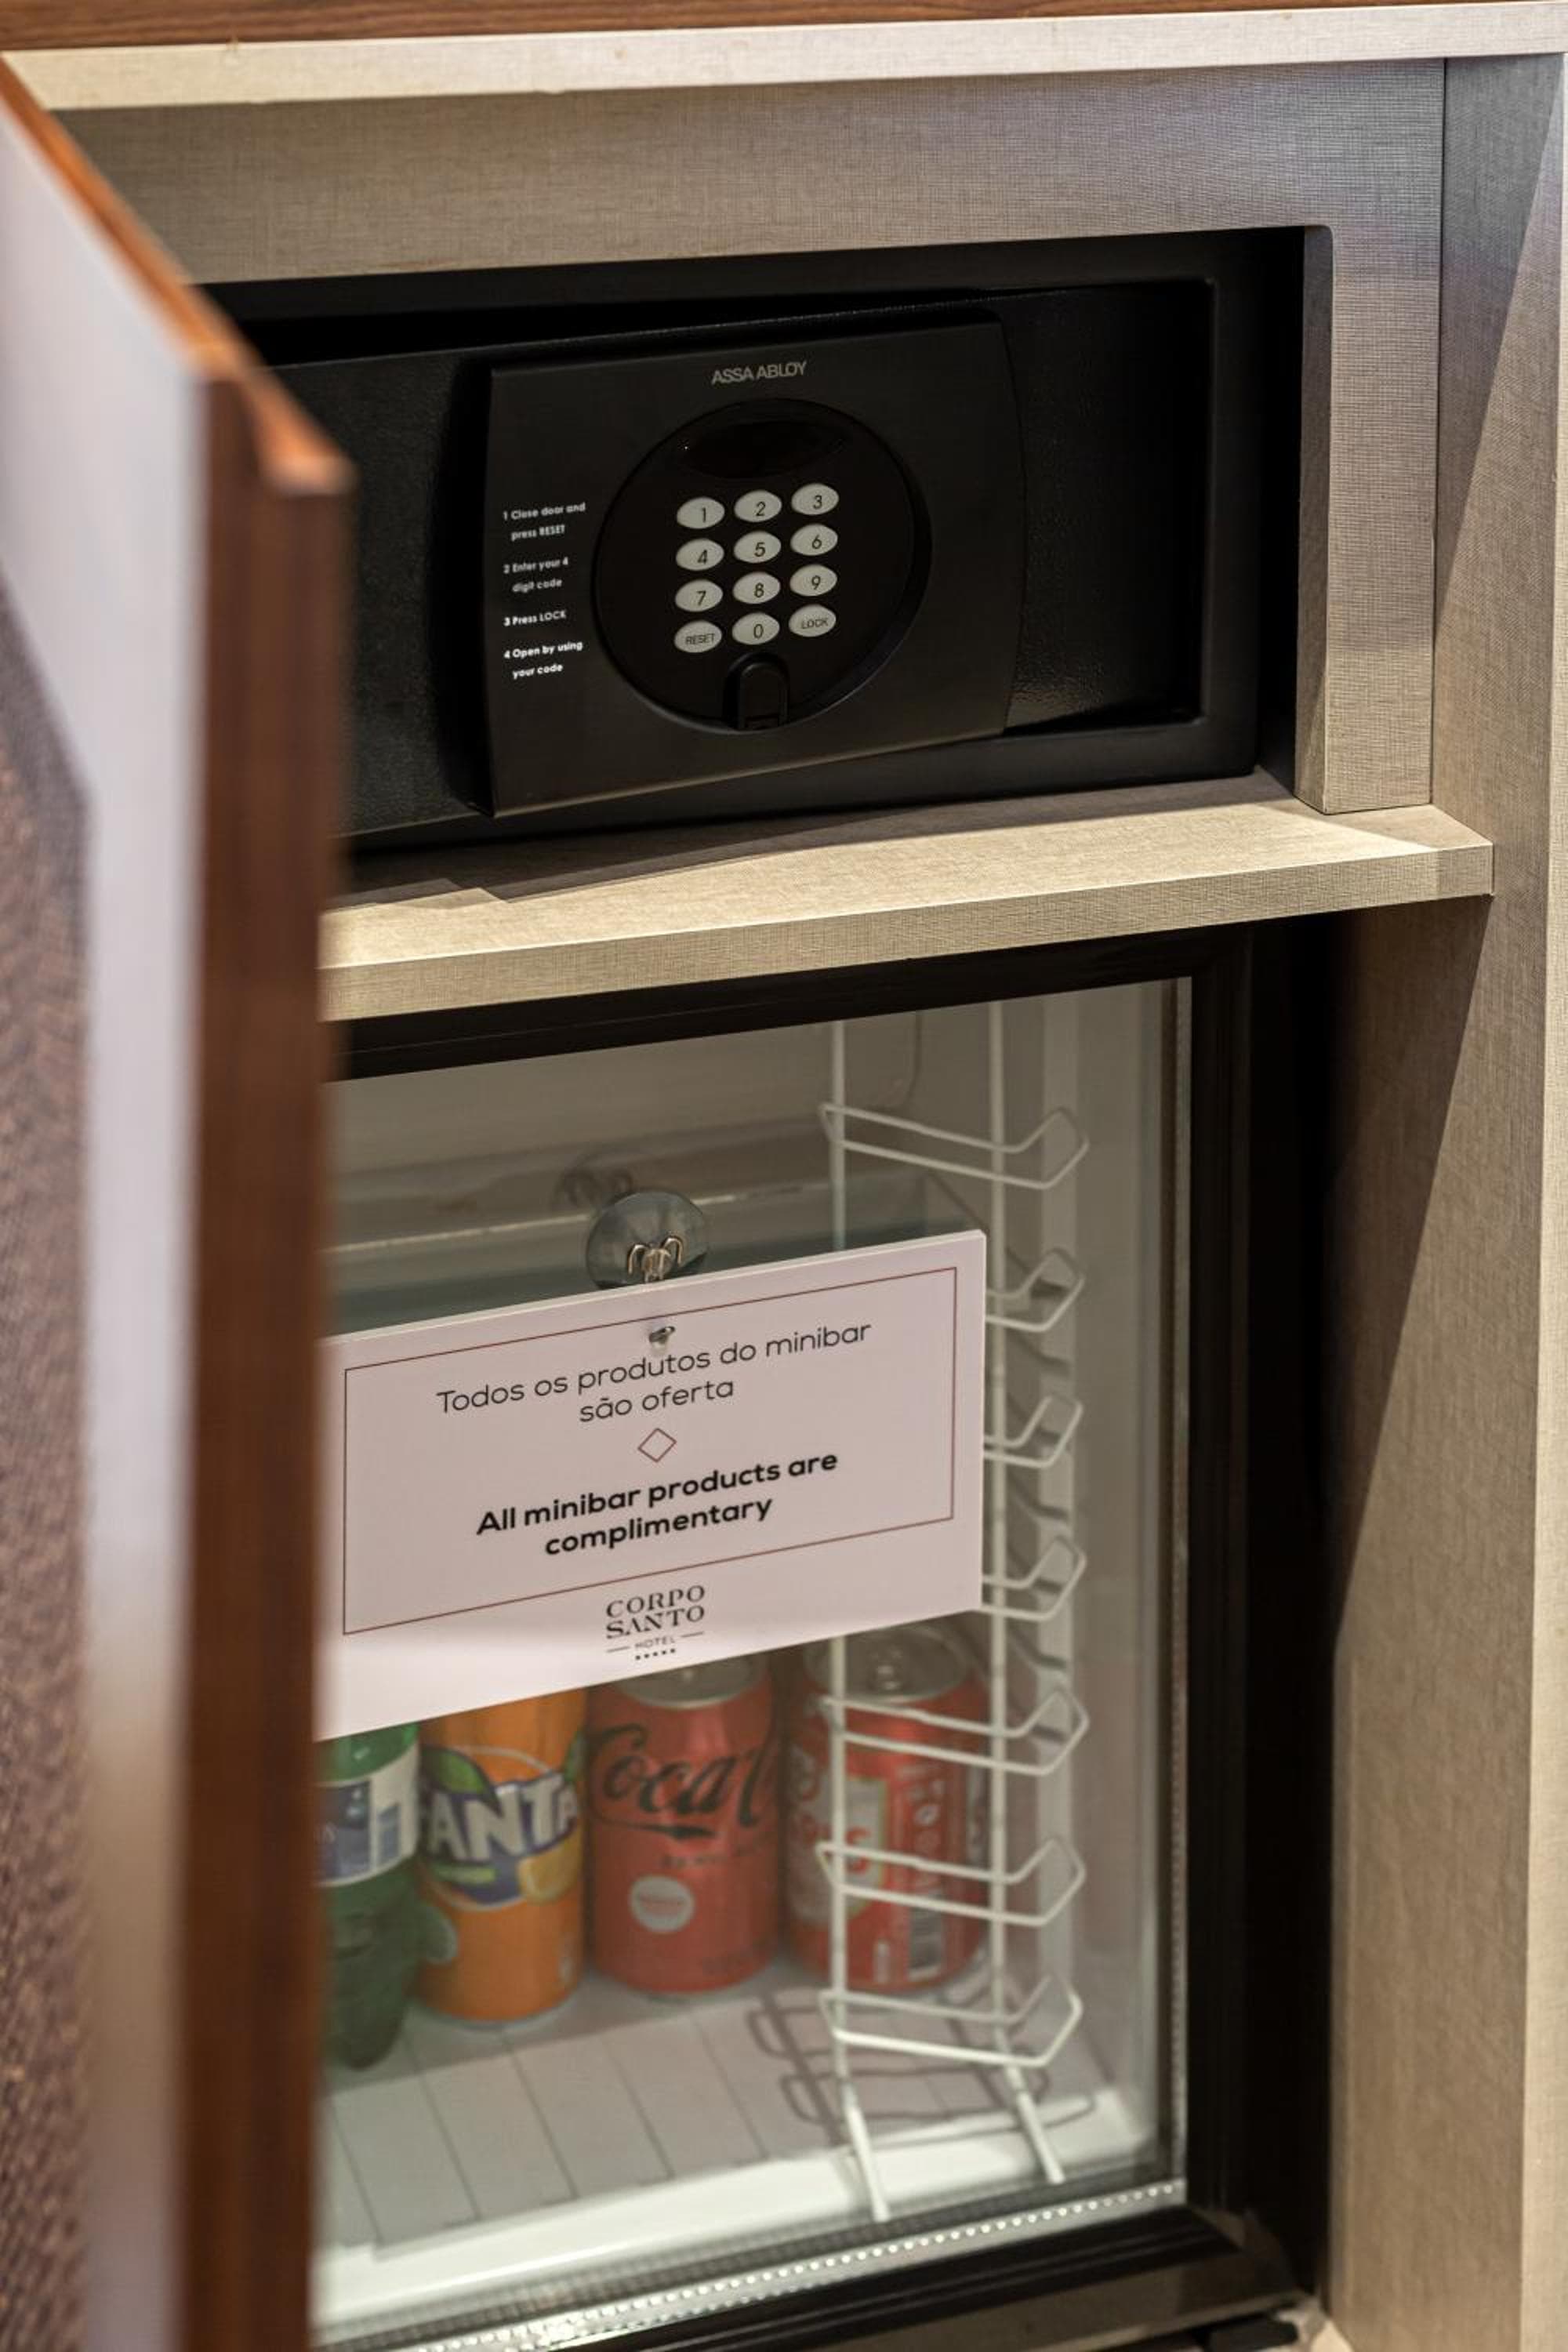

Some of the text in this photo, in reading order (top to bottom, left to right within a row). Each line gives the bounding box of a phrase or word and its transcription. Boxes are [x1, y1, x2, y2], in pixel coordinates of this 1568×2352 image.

[711, 360, 807, 385] ASSA ABLOY
[755, 501, 766, 517] 2
[813, 495, 823, 509] 3
[510, 509, 539, 520] Close
[540, 506, 564, 516] door
[565, 502, 586, 513] and
[699, 506, 707, 523] 1
[753, 542, 766, 557] 5
[811, 535, 822, 550] 6
[697, 550, 708, 564] 4
[536, 578, 562, 589] code
[753, 583, 764, 598] 8
[811, 575, 821, 590] 9
[696, 590, 707, 606] 7
[503, 609, 567, 626] 3 Press LOCK
[801, 619, 829, 630] LOCK
[685, 633, 715, 645] RESET
[753, 623, 764, 639] 0
[503, 641, 583, 659] 4 Open by using
[512, 663, 564, 680] your code
[436, 1324, 871, 1414] Todos os produtos do minibar
[579, 1381, 733, 1423] são oferta
[476, 1454, 838, 1535] All minibar products are
[545, 1498, 772, 1555] complimentary
[606, 1584, 705, 1618] CORPO
[606, 1605, 705, 1639] SANTO
[634, 1636, 675, 1648] HOTEL
